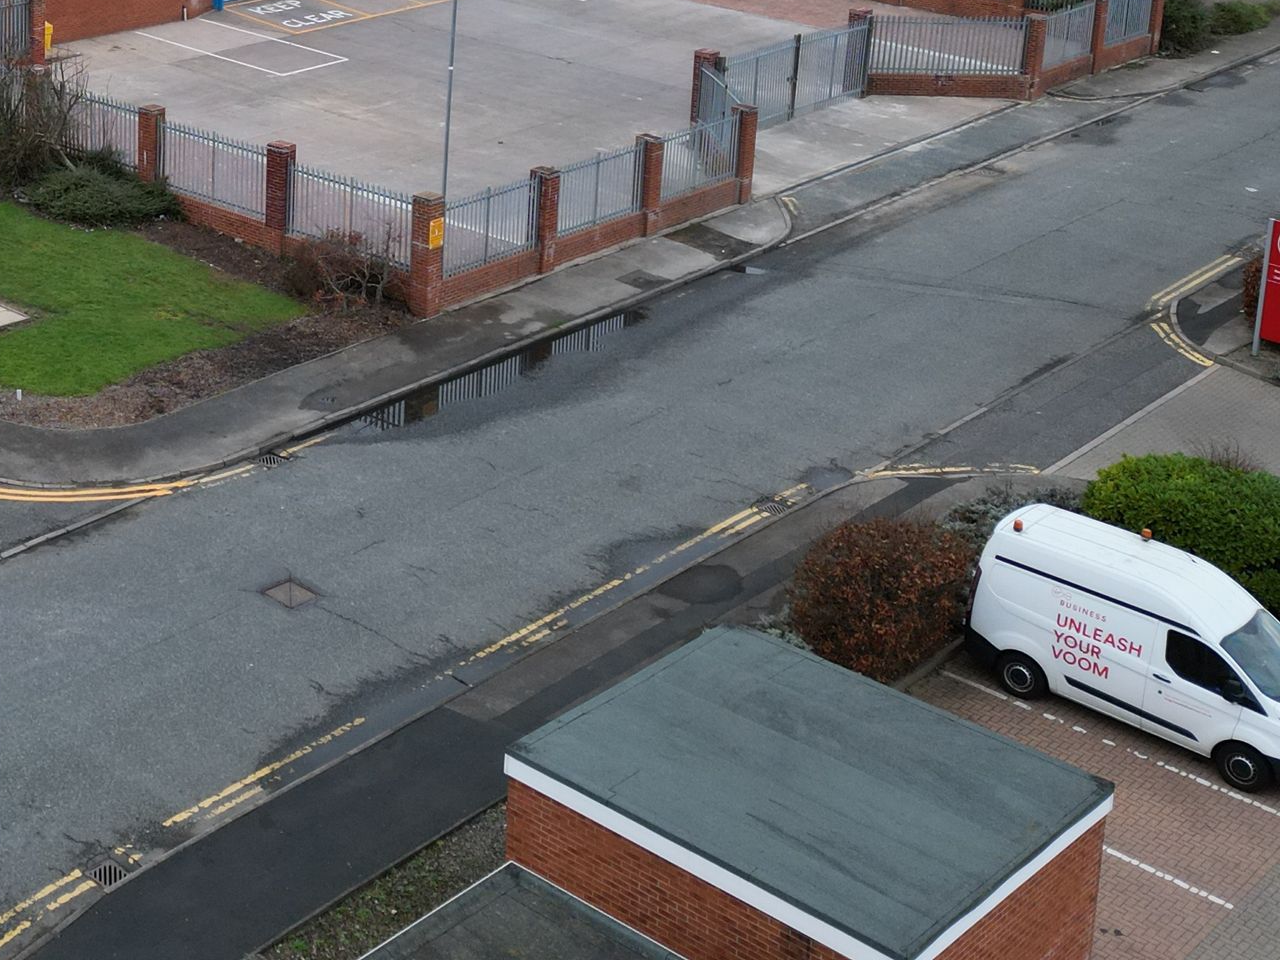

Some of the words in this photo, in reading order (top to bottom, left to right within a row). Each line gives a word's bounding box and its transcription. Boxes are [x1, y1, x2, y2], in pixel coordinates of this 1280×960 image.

[282, 8, 353, 29] CLEAR
[1060, 599, 1107, 622] BUSINESS
[1054, 629, 1102, 660] YOUR
[1056, 613, 1143, 658] UNLEASH
[1051, 644, 1109, 680] VOOM
